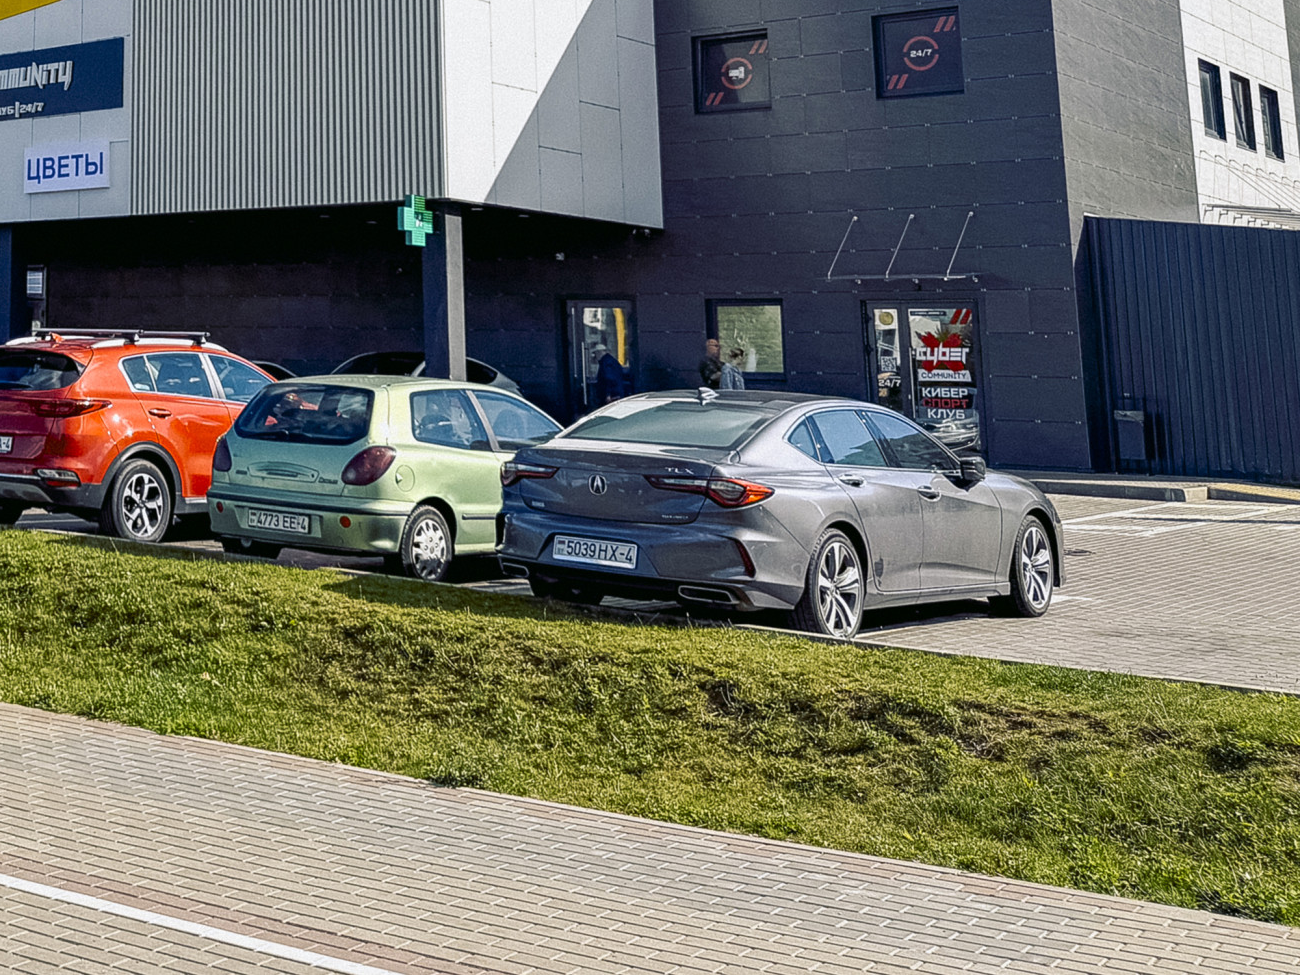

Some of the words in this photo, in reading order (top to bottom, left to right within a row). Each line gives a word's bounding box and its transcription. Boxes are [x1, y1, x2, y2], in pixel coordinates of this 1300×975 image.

[910, 49, 932, 58] 24/7
[27, 152, 103, 184] ЦВЕТЫ
[878, 379, 901, 388] 24/7
[922, 388, 968, 398] КИБЕР
[922, 399, 968, 408] СПОРТ
[928, 409, 965, 420] КЛУБ
